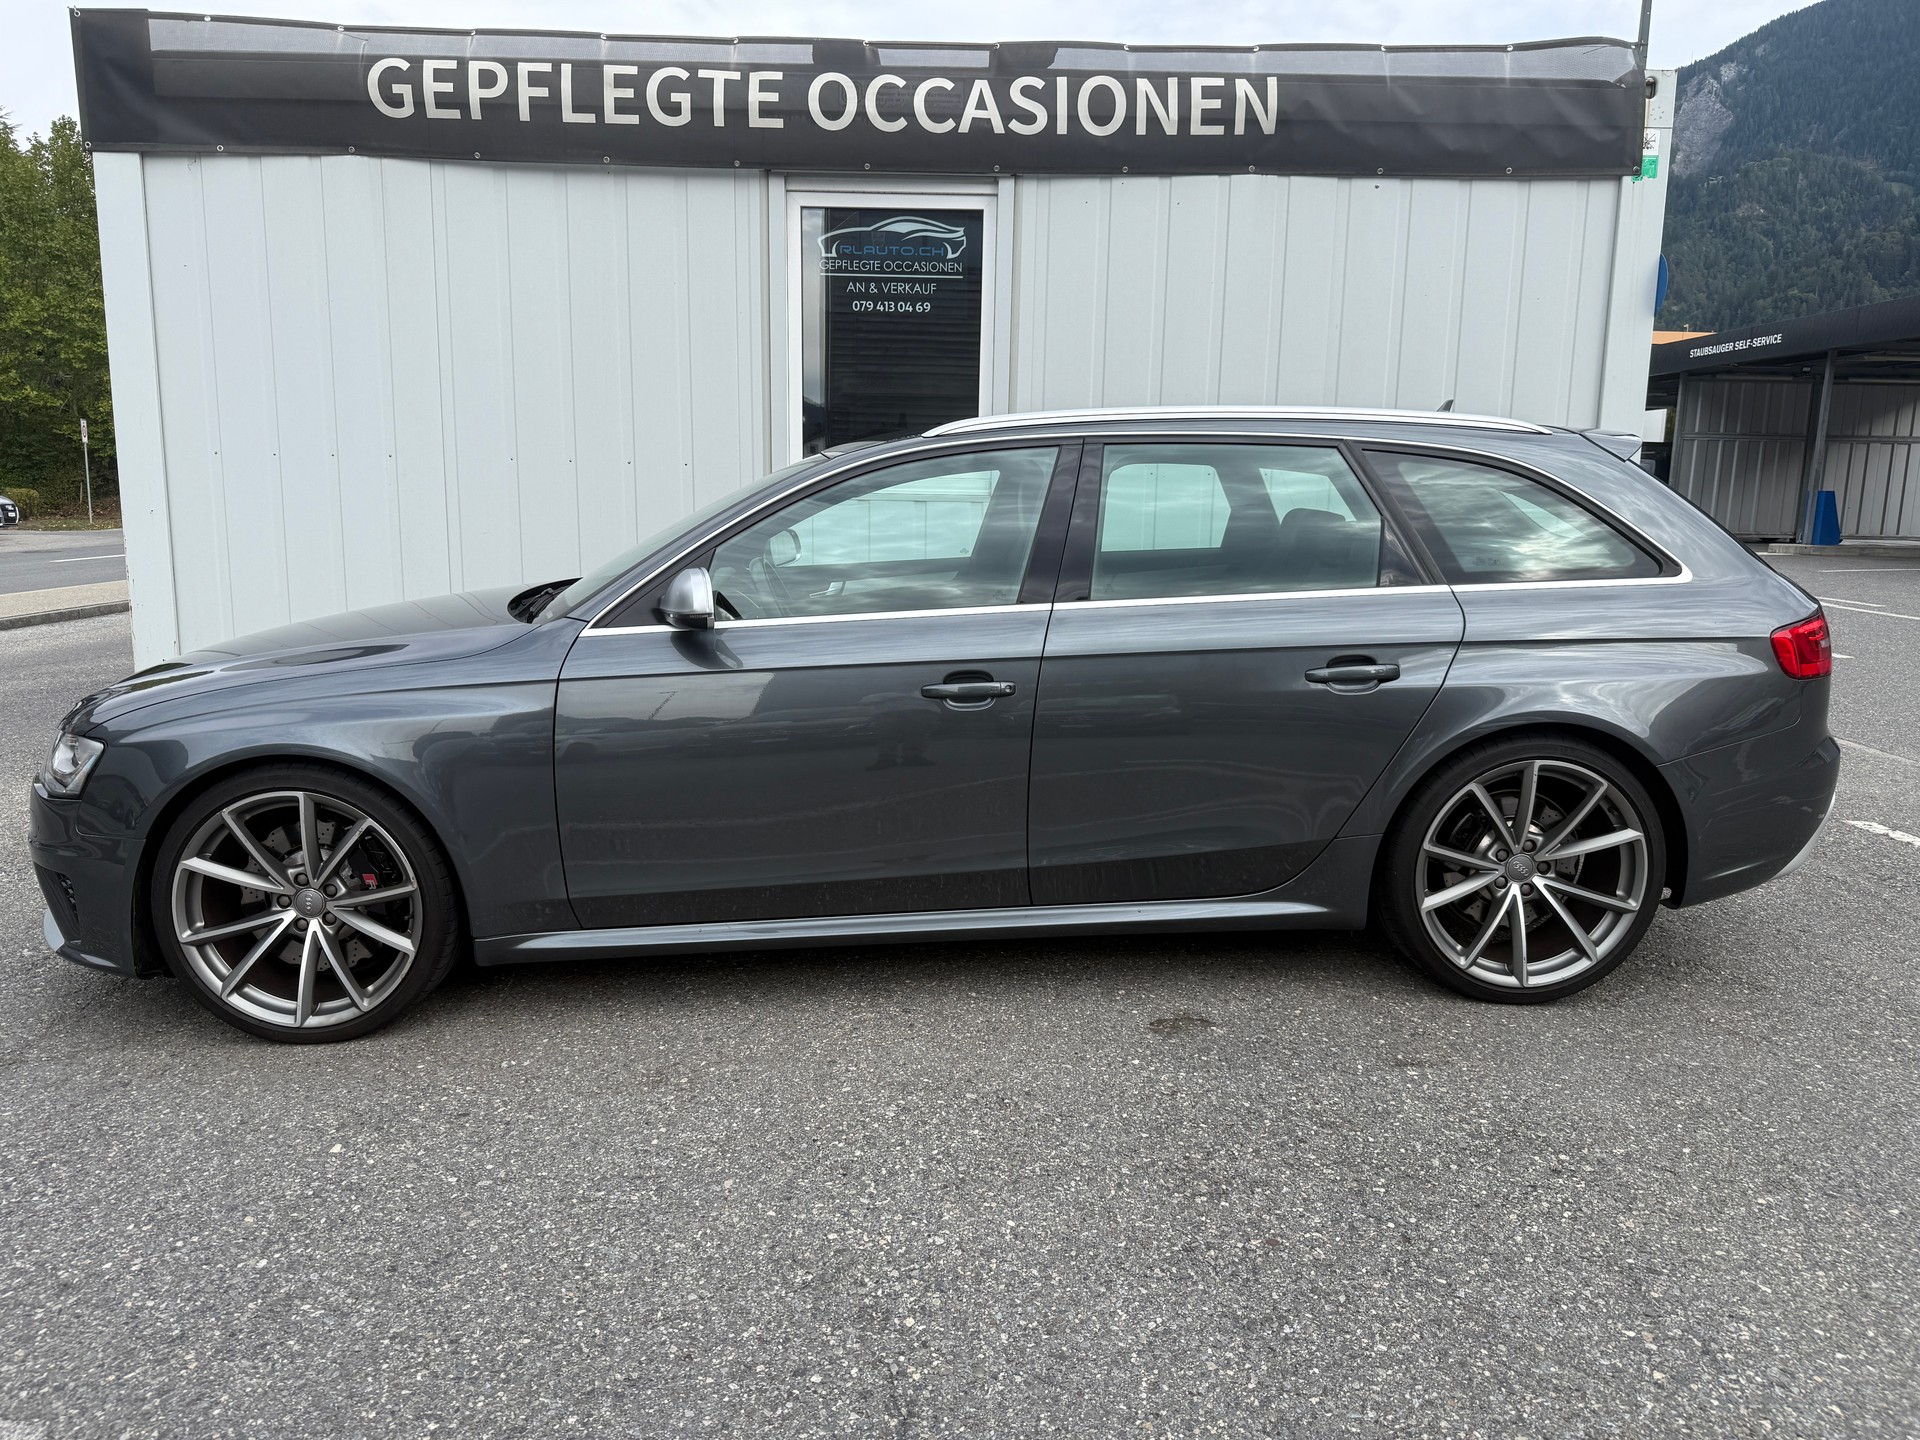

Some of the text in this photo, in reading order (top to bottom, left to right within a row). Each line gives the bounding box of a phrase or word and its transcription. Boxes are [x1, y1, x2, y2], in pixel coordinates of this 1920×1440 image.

[367, 57, 1278, 136] GEPFLEGTE OCCASIONEN
[839, 245, 944, 257] RLAUTO.CH
[819, 259, 963, 273] GEPFLEGTE OCCASIONEN
[846, 281, 937, 295] AN & VERKAUF
[852, 301, 931, 313] 079 413 04 69
[1689, 333, 1783, 358] STAUBSAUGER SELF-SERVICE
